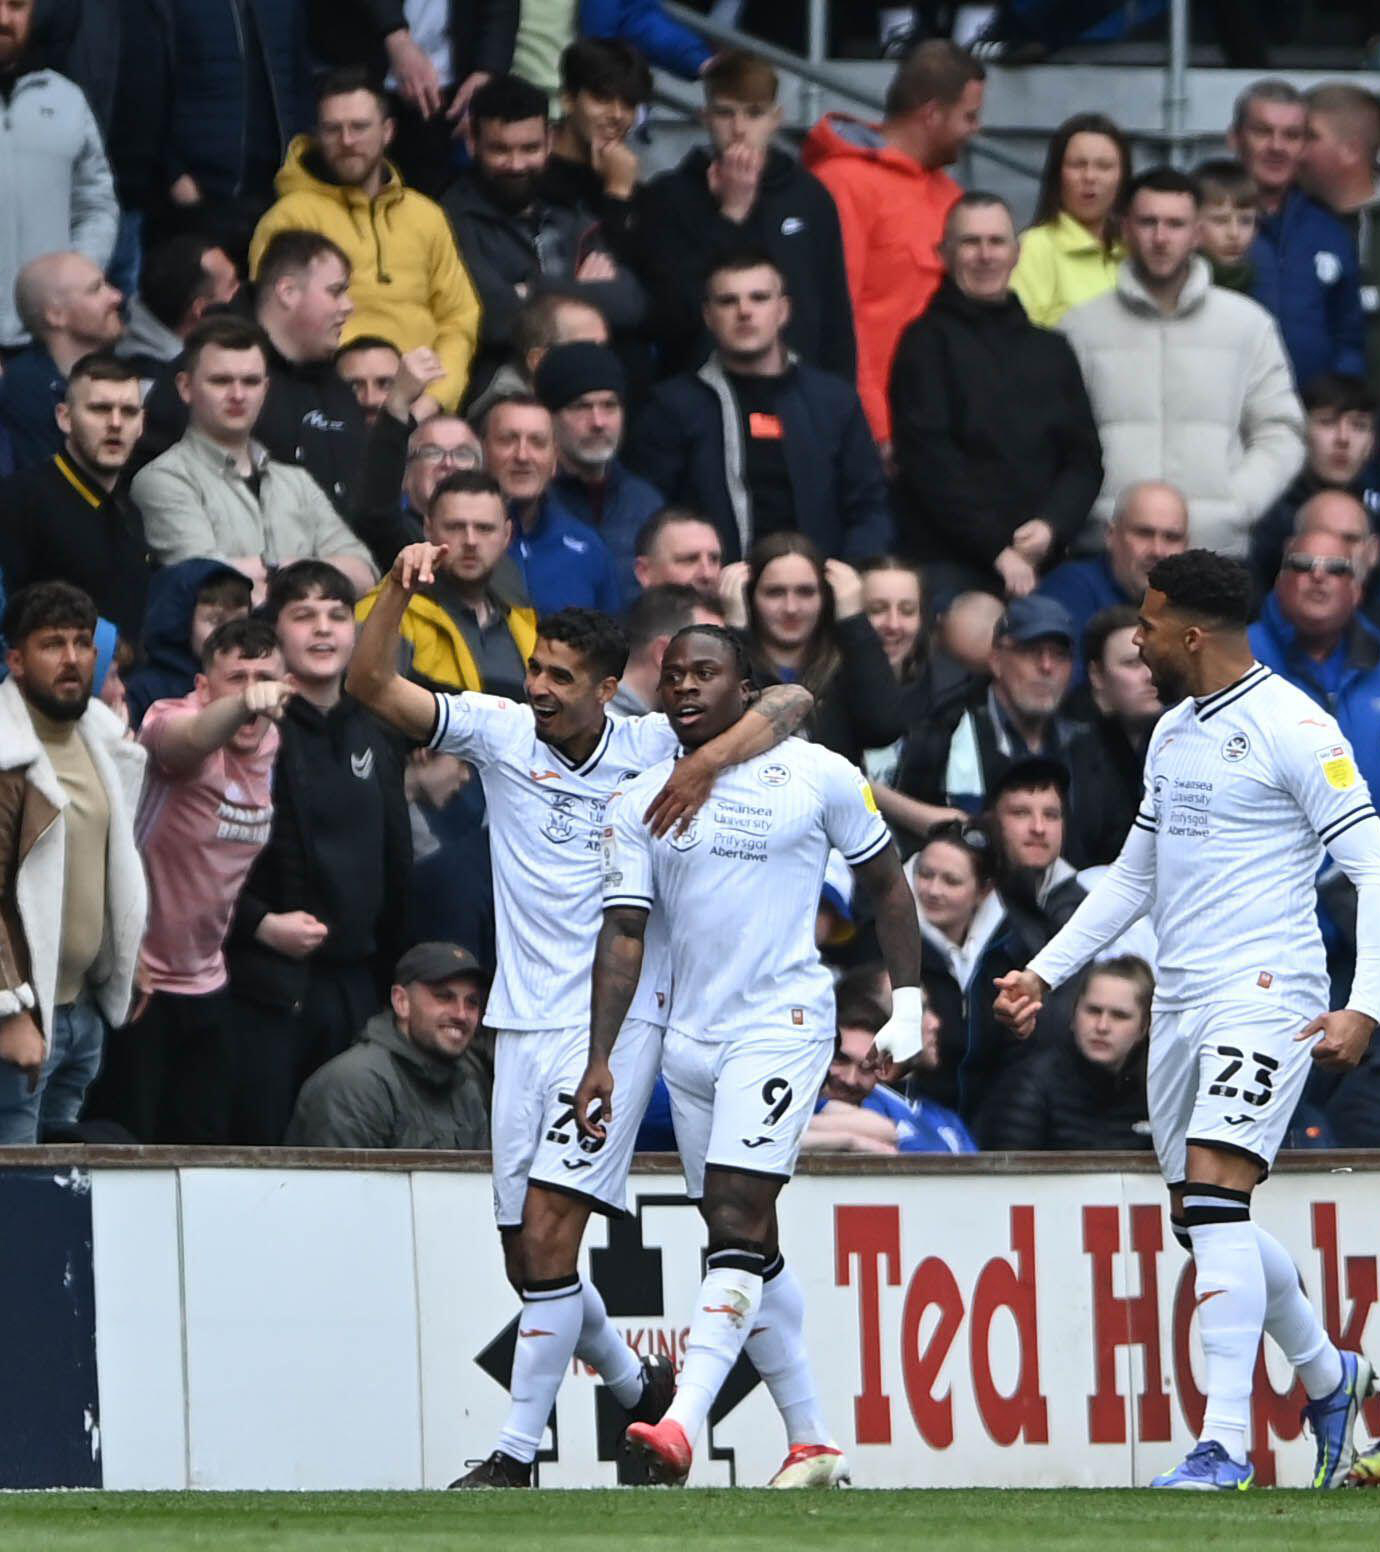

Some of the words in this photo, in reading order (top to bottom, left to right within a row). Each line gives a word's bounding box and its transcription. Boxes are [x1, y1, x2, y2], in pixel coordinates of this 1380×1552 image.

[714, 811, 772, 831] University
[717, 801, 772, 817] Swansea
[709, 846, 768, 862] Abertawe
[1208, 1046, 1279, 1107] 23
[762, 1077, 792, 1127] 9
[834, 1204, 1048, 1451] Ted
